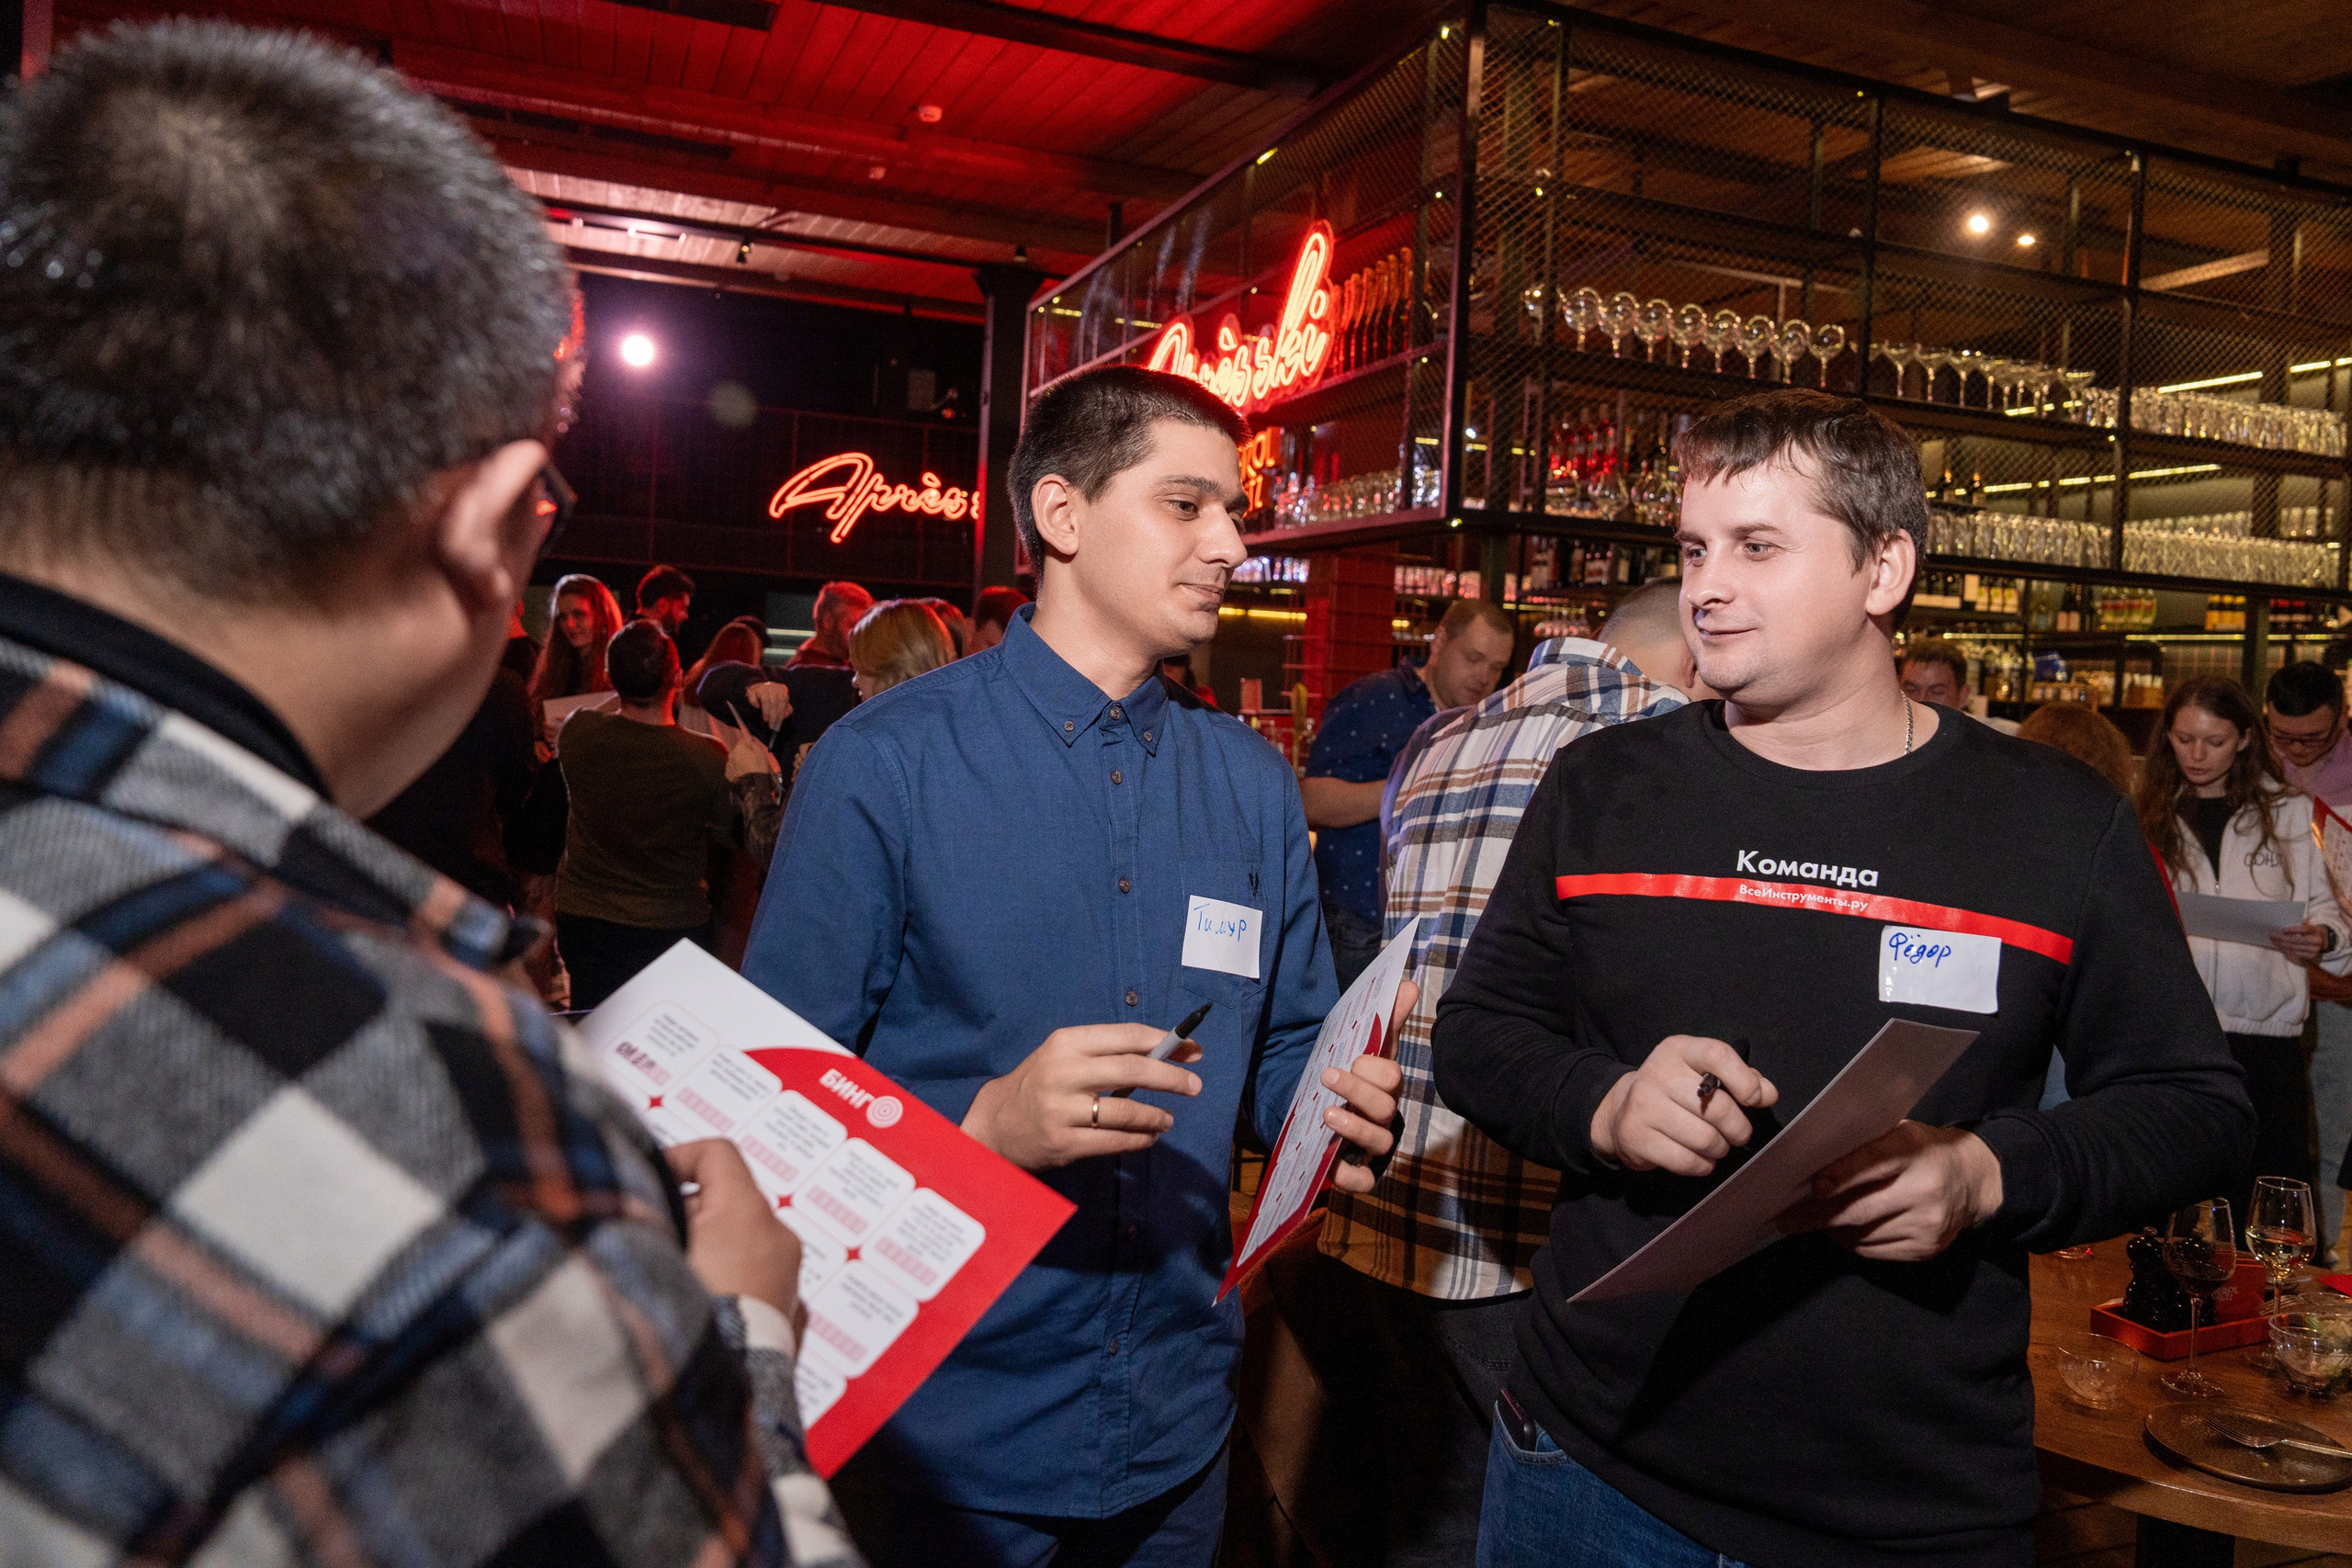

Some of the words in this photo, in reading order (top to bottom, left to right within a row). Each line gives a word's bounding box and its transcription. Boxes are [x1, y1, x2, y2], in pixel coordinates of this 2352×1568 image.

[1252, 231, 1328, 399] ski
[768, 451, 968, 545] Après
[1736, 849, 1879, 888] Команда
[1739, 883, 1869, 912] ВсеИнструменты.ру
[1193, 902, 1248, 942] Тимур
[1888, 931, 1951, 968] Фёдор
